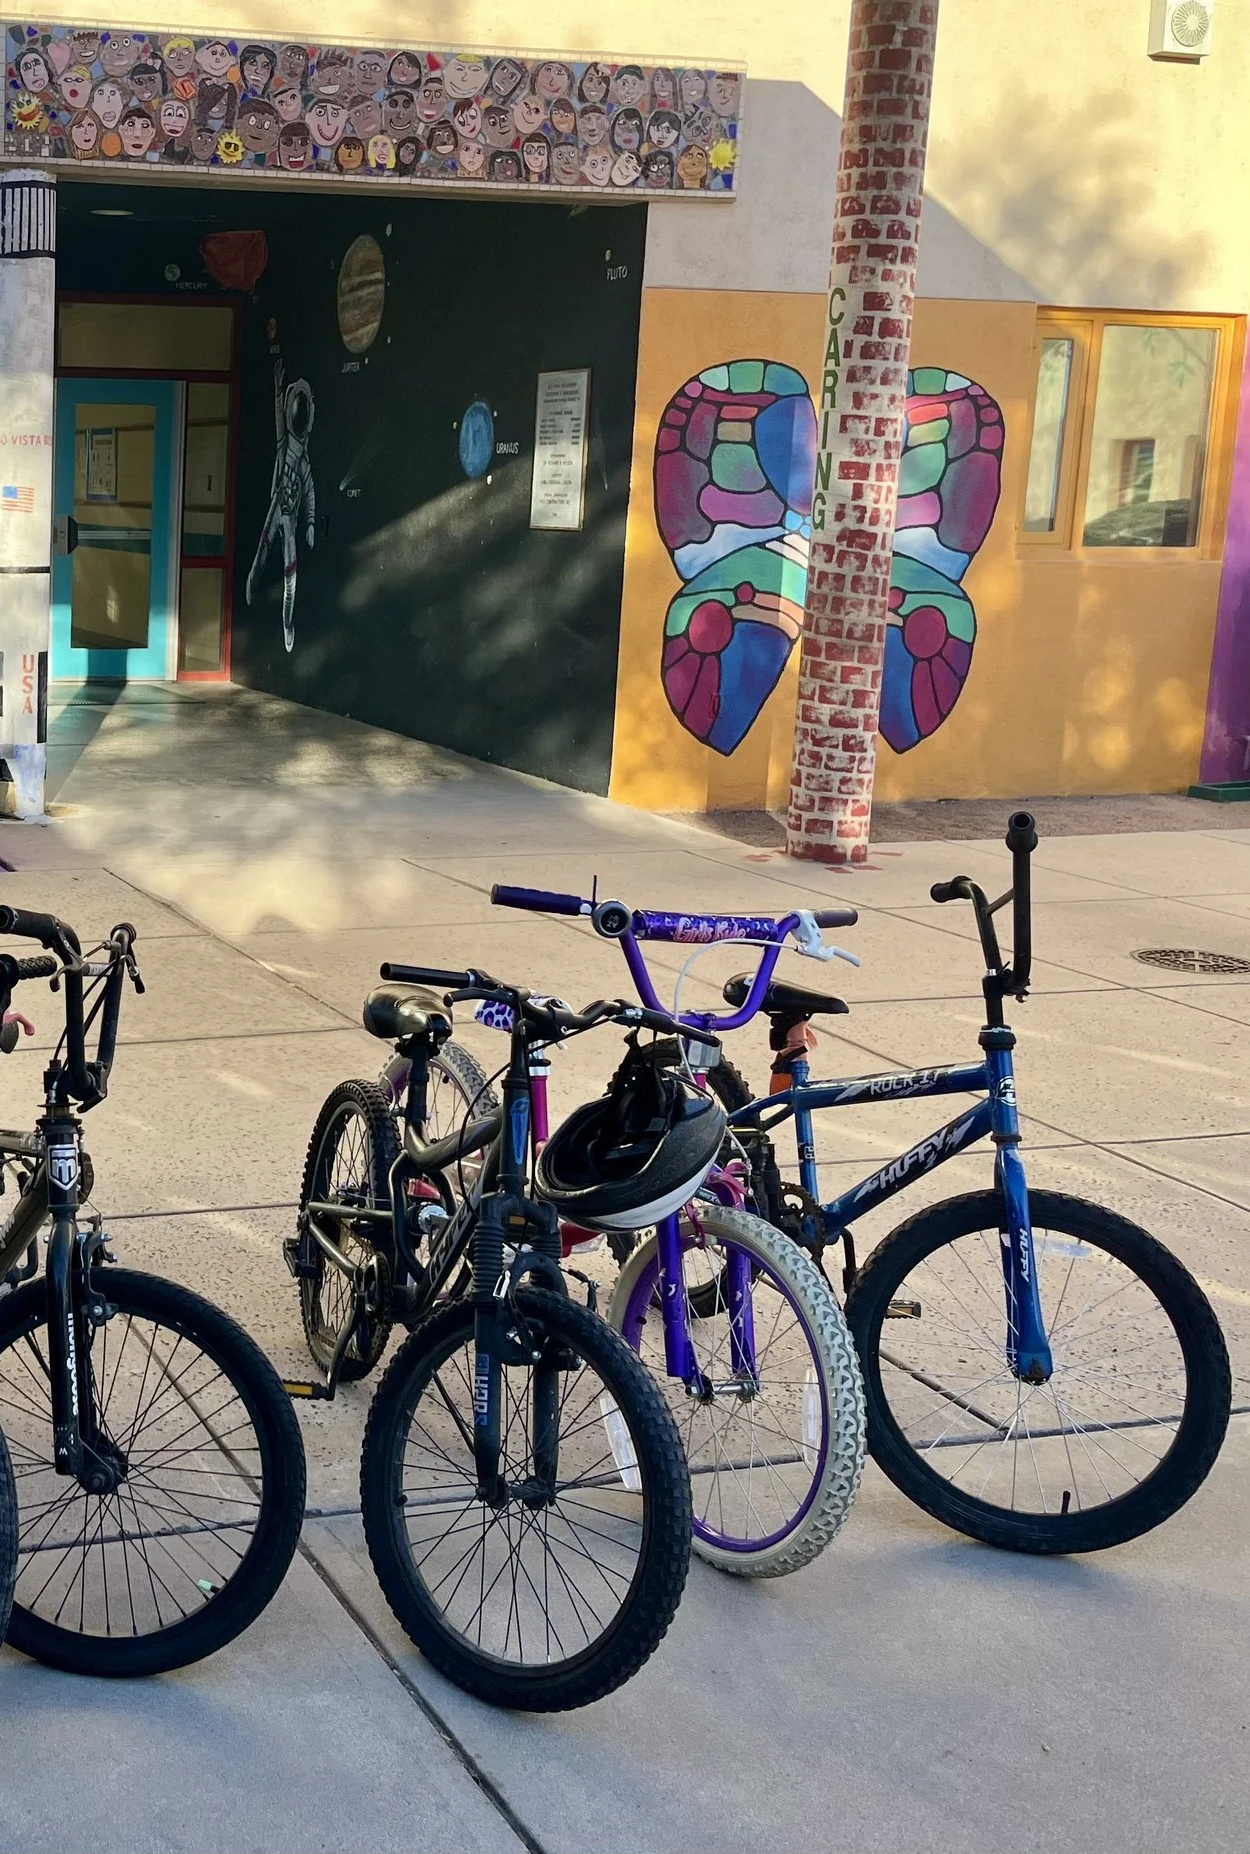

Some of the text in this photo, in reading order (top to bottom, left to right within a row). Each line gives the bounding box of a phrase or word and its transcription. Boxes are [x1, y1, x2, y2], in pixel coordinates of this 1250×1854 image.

[606, 265, 628, 281] PLUTO
[812, 287, 846, 531] CARING
[11, 434, 42, 446] VISTA
[496, 441, 519, 455] URANUS
[21, 654, 35, 715] USA
[870, 1070, 940, 1096] ROCK IT
[877, 1126, 950, 1190] HUFFY
[1019, 1228, 1030, 1282] HUFFY
